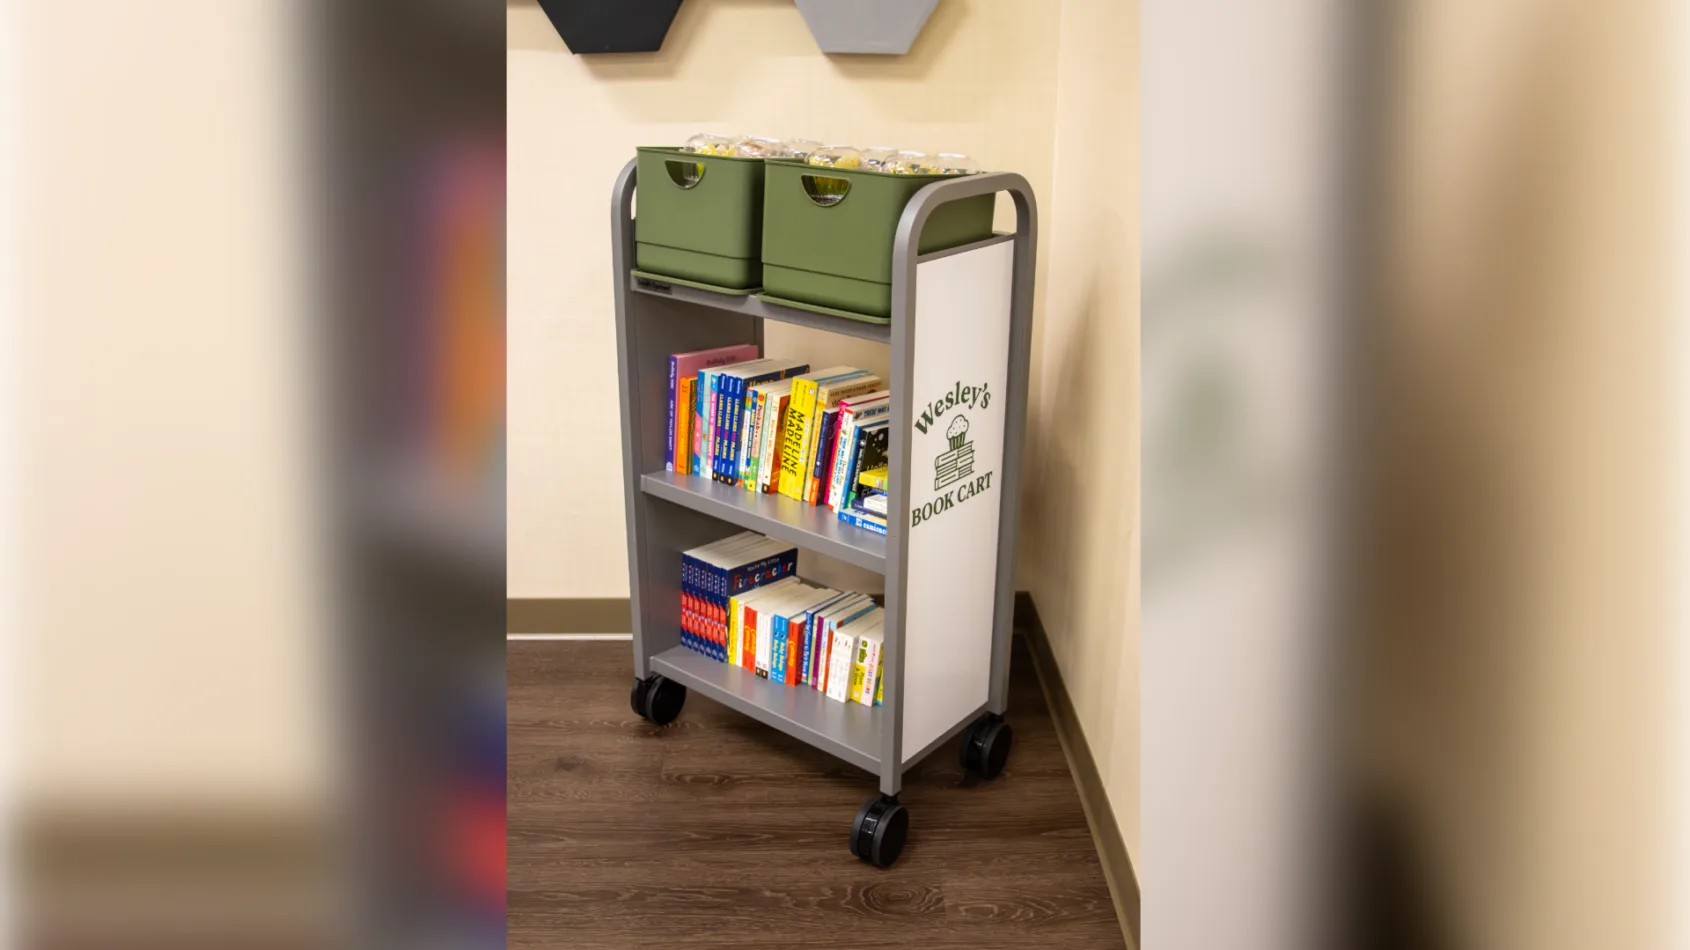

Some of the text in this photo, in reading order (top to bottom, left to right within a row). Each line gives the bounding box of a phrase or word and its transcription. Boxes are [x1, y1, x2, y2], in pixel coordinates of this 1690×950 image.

[914, 380, 991, 435] Wesley's
[781, 408, 797, 472] MADELINE
[789, 412, 805, 477] MADELINE
[911, 471, 993, 528] BOOK CART
[733, 561, 794, 591] Firecracker
